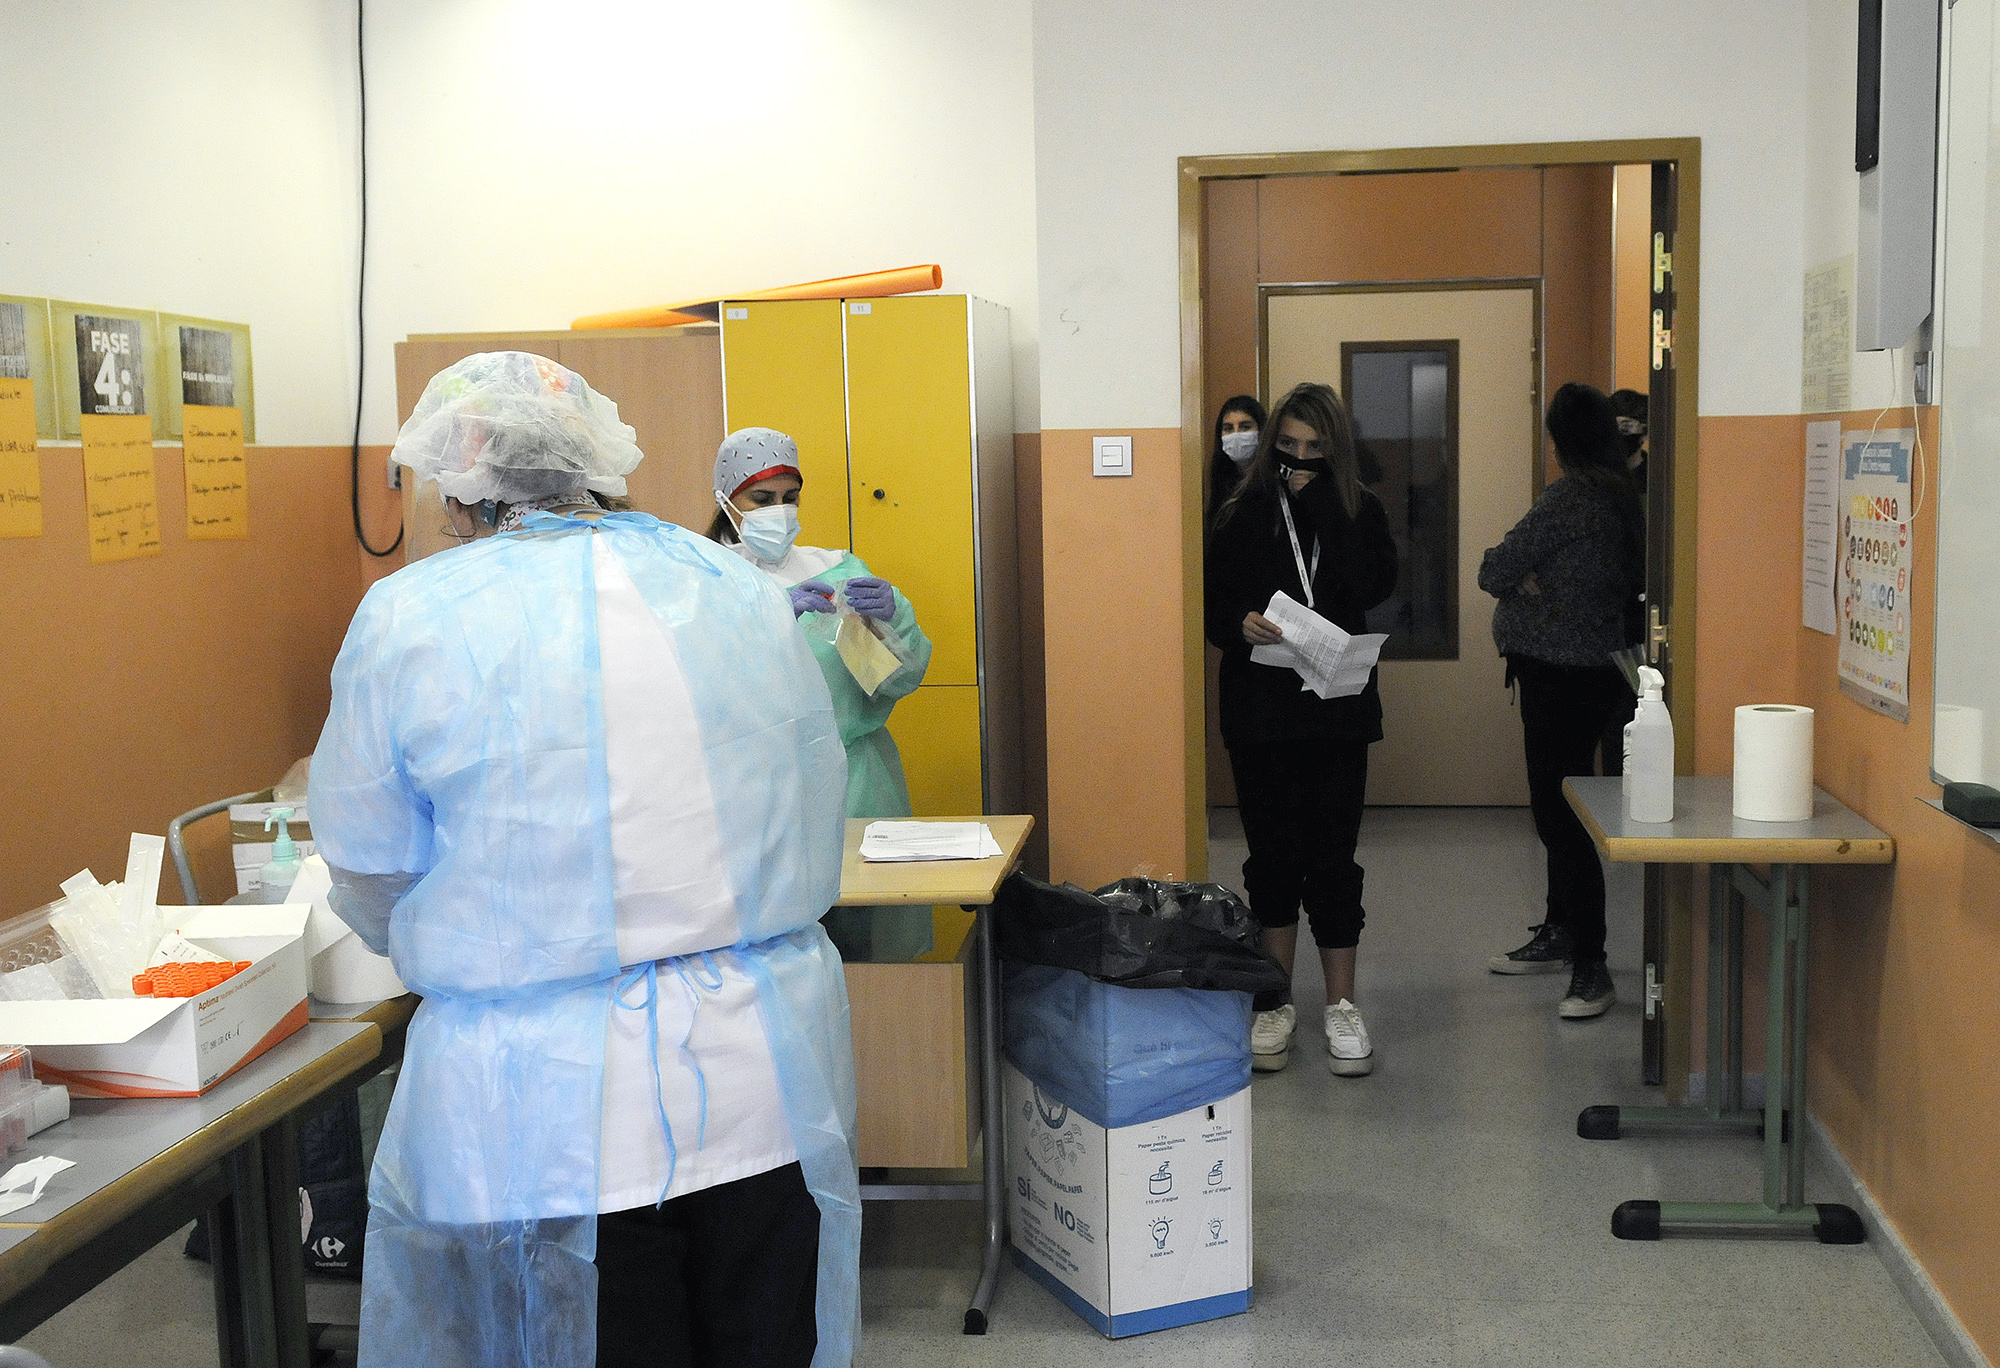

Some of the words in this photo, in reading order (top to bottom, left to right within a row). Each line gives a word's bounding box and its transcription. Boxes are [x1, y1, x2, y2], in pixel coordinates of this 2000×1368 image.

[90, 330, 130, 354] FASE
[93, 351, 132, 406] 4:
[198, 996, 219, 1011] Aptima
[1017, 1176, 1031, 1201] SÍ
[1054, 1201, 1075, 1231] NO
